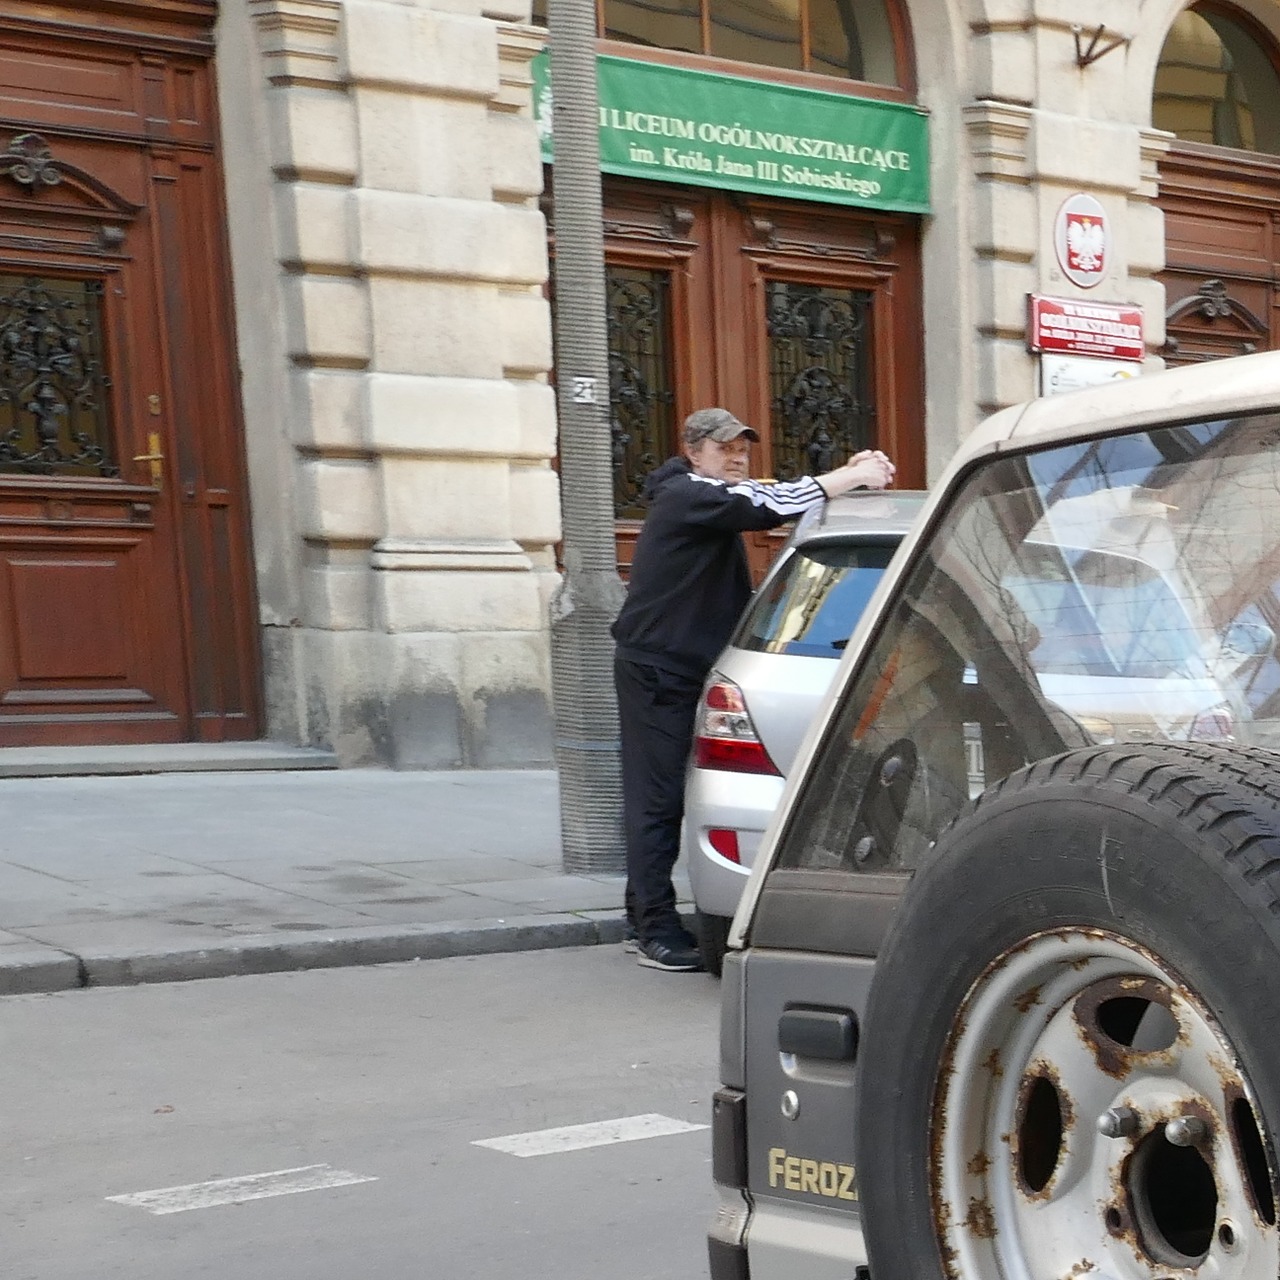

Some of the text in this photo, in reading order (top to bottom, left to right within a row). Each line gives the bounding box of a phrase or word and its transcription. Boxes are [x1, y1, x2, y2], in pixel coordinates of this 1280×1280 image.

[611, 108, 695, 140] LICEUM
[699, 122, 910, 172] OGÓLNOKSZTAŁCĄCE
[629, 141, 881, 198] im. Króla Jana III Sobieskiego
[768, 1147, 859, 1201] FEROZ
